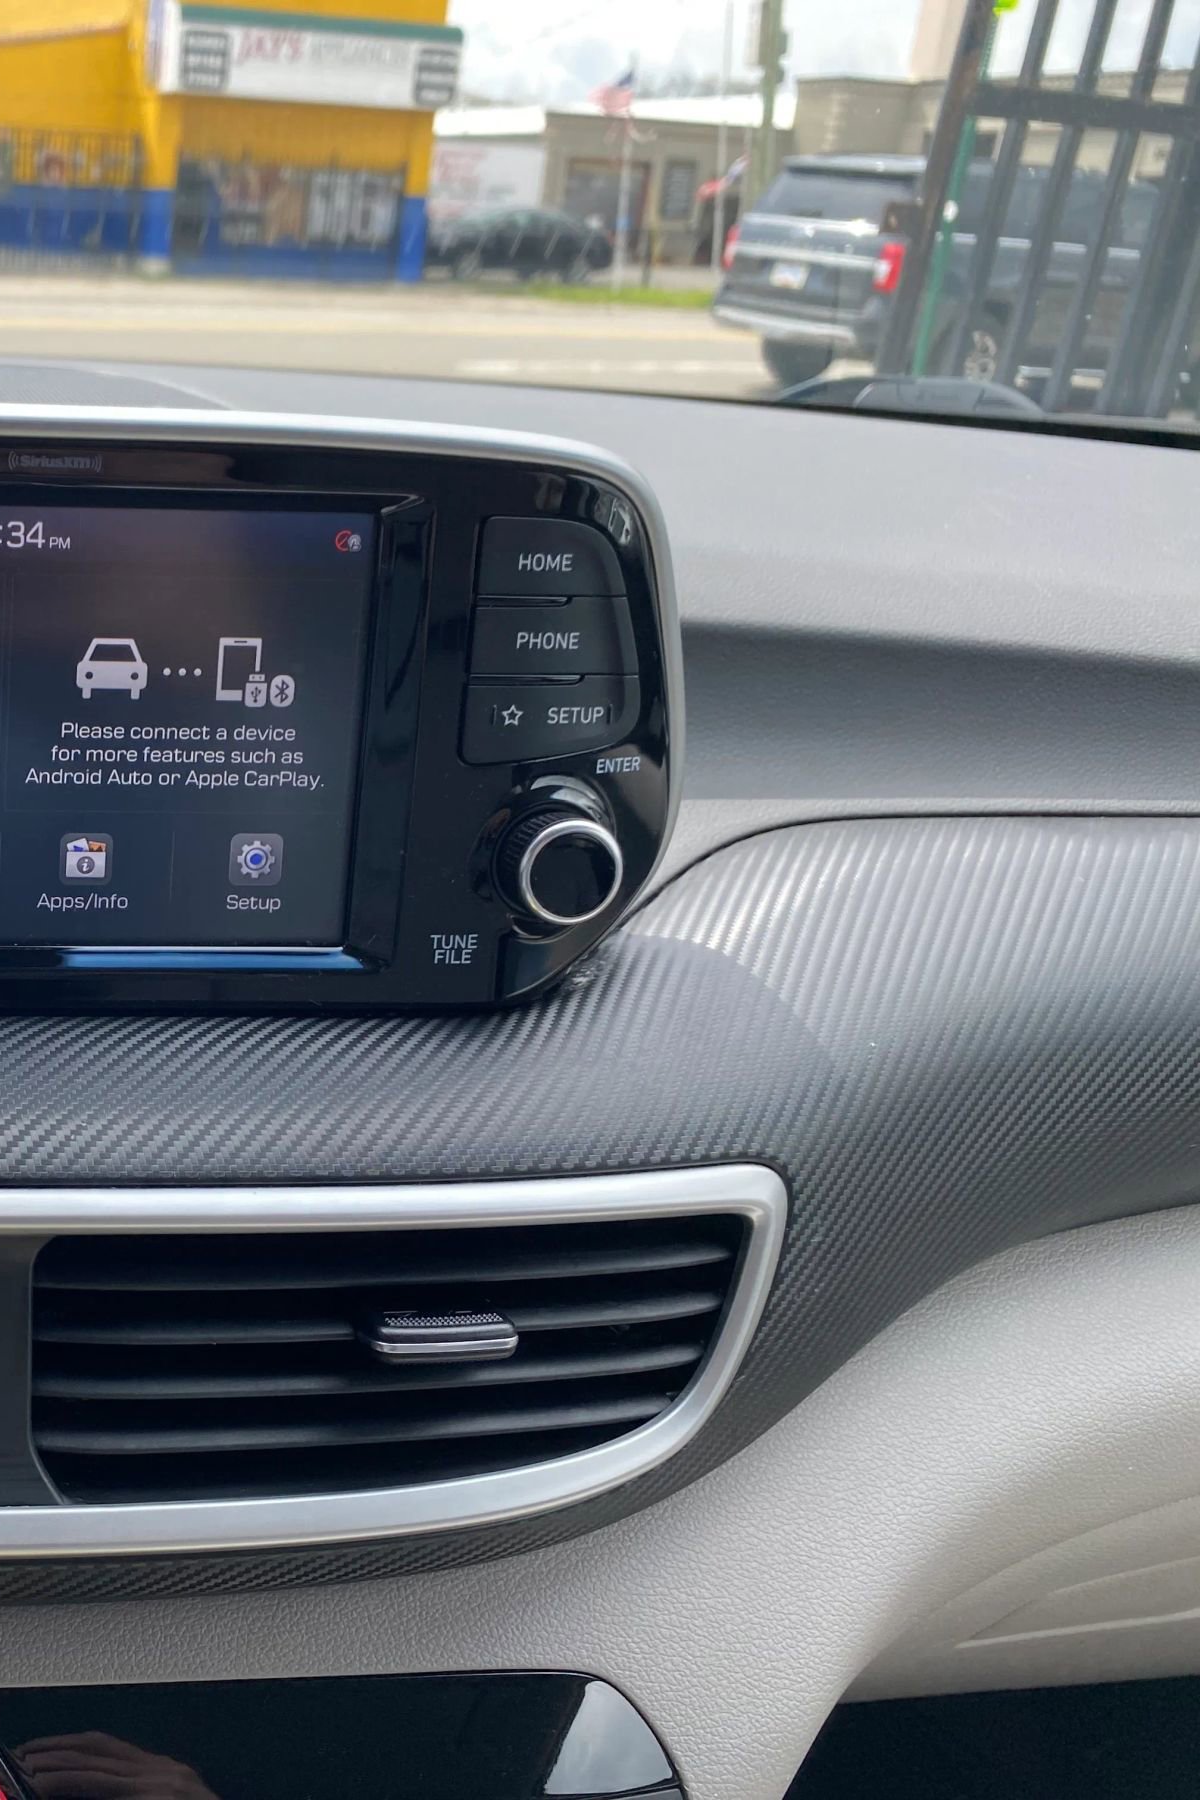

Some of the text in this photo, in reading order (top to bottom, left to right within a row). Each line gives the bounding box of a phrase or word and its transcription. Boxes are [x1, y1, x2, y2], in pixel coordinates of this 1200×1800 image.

[518, 553, 573, 572] HOME
[516, 631, 581, 650] PHONE
[547, 706, 605, 725] SETUP
[60, 721, 296, 742] Please connect a device
[51, 745, 305, 765] for more features such as
[596, 755, 643, 774] ENTER
[24, 768, 325, 791] Android Auto or Apple CarPlay.
[36, 892, 129, 913] Apps/Info
[226, 894, 281, 914] Setup
[430, 933, 478, 950] TUNE
[433, 948, 472, 965] FILE
